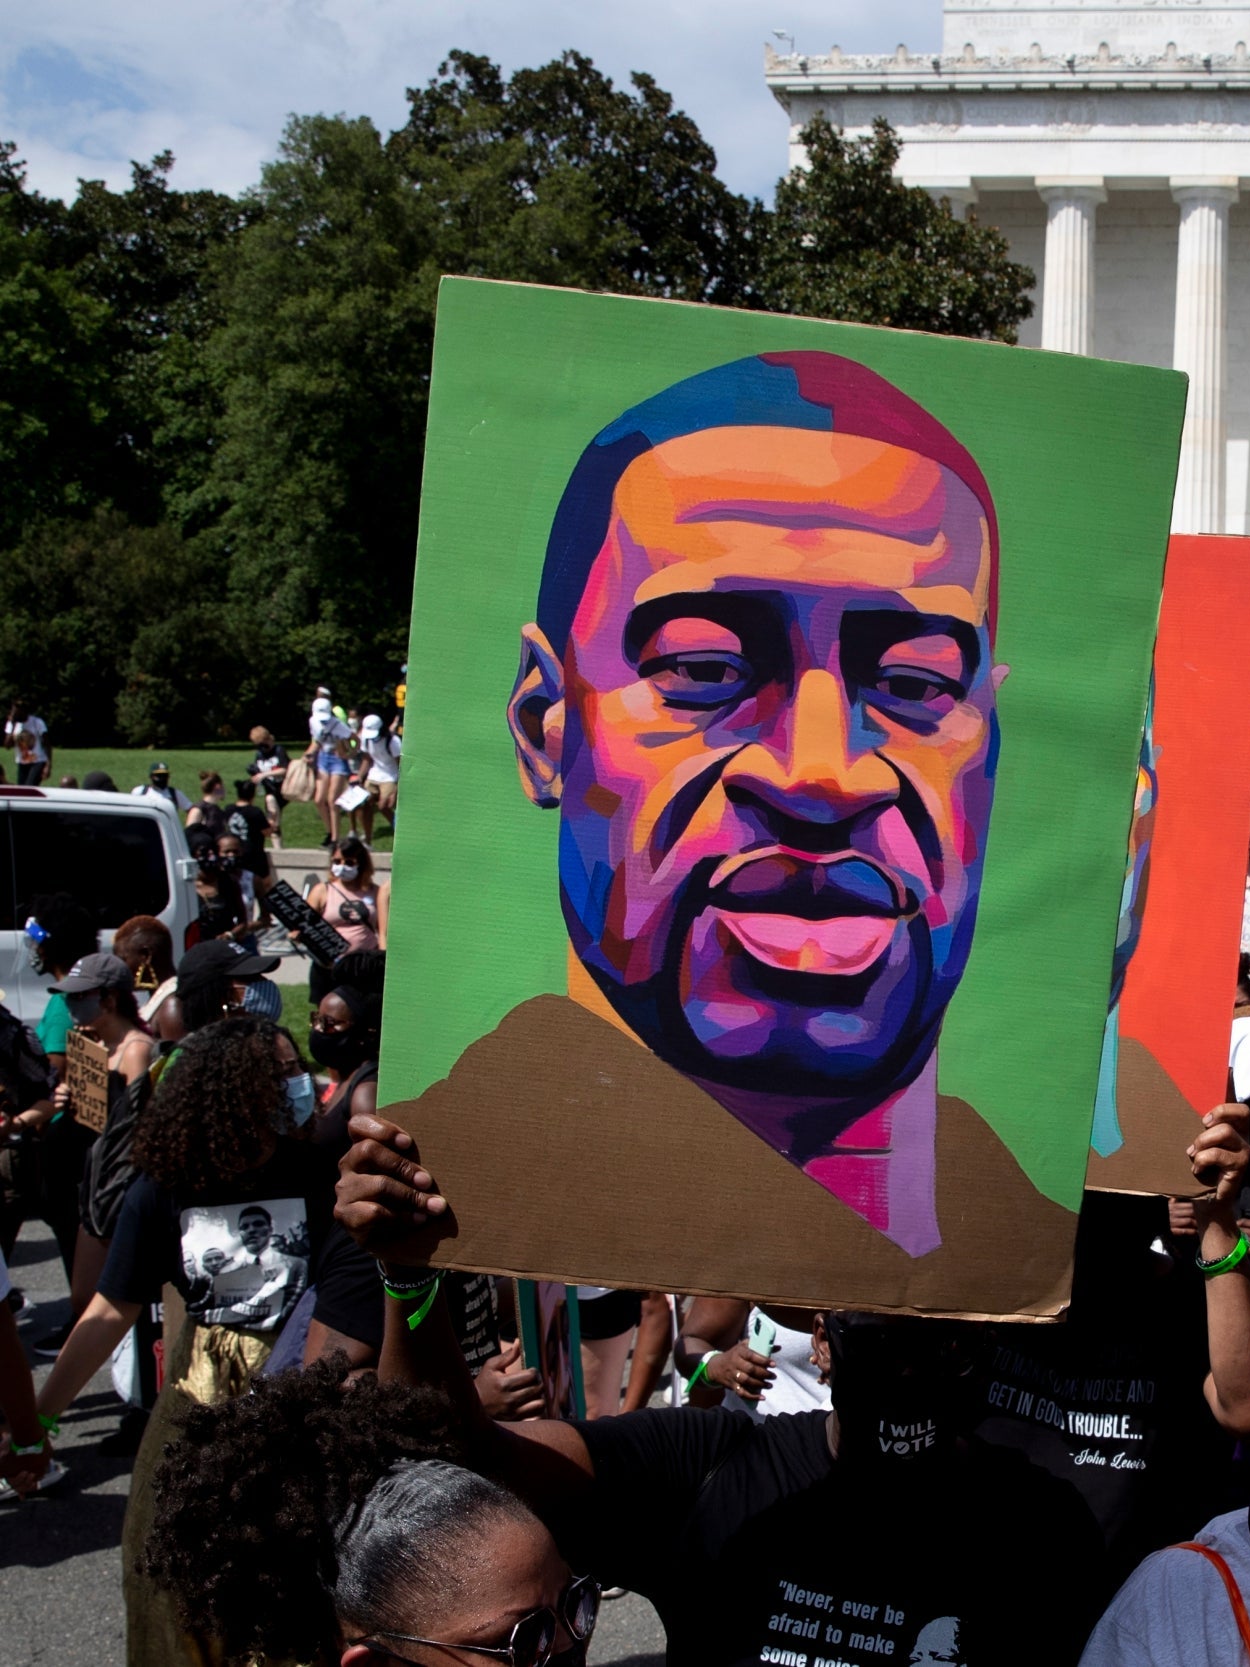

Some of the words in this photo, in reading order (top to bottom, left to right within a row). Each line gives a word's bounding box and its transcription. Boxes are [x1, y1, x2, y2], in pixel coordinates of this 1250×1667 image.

[67, 1031, 85, 1050] NO
[68, 1074, 87, 1092] NO
[987, 1379, 1017, 1410] GET
[1016, 1391, 1035, 1417] IN
[1066, 1410, 1144, 1441] TROUBLE...
[880, 1419, 885, 1433] I
[890, 1419, 937, 1438] WILL
[879, 1432, 937, 1455] VOTE
[1110, 1452, 1148, 1471] Lewis
[779, 1579, 834, 1614] "Never,
[841, 1599, 879, 1622] ever
[883, 1604, 905, 1626] be
[768, 1612, 821, 1640] afraid
[824, 1623, 843, 1645] to
[849, 1631, 895, 1656] make
[760, 1643, 808, 1667] some
